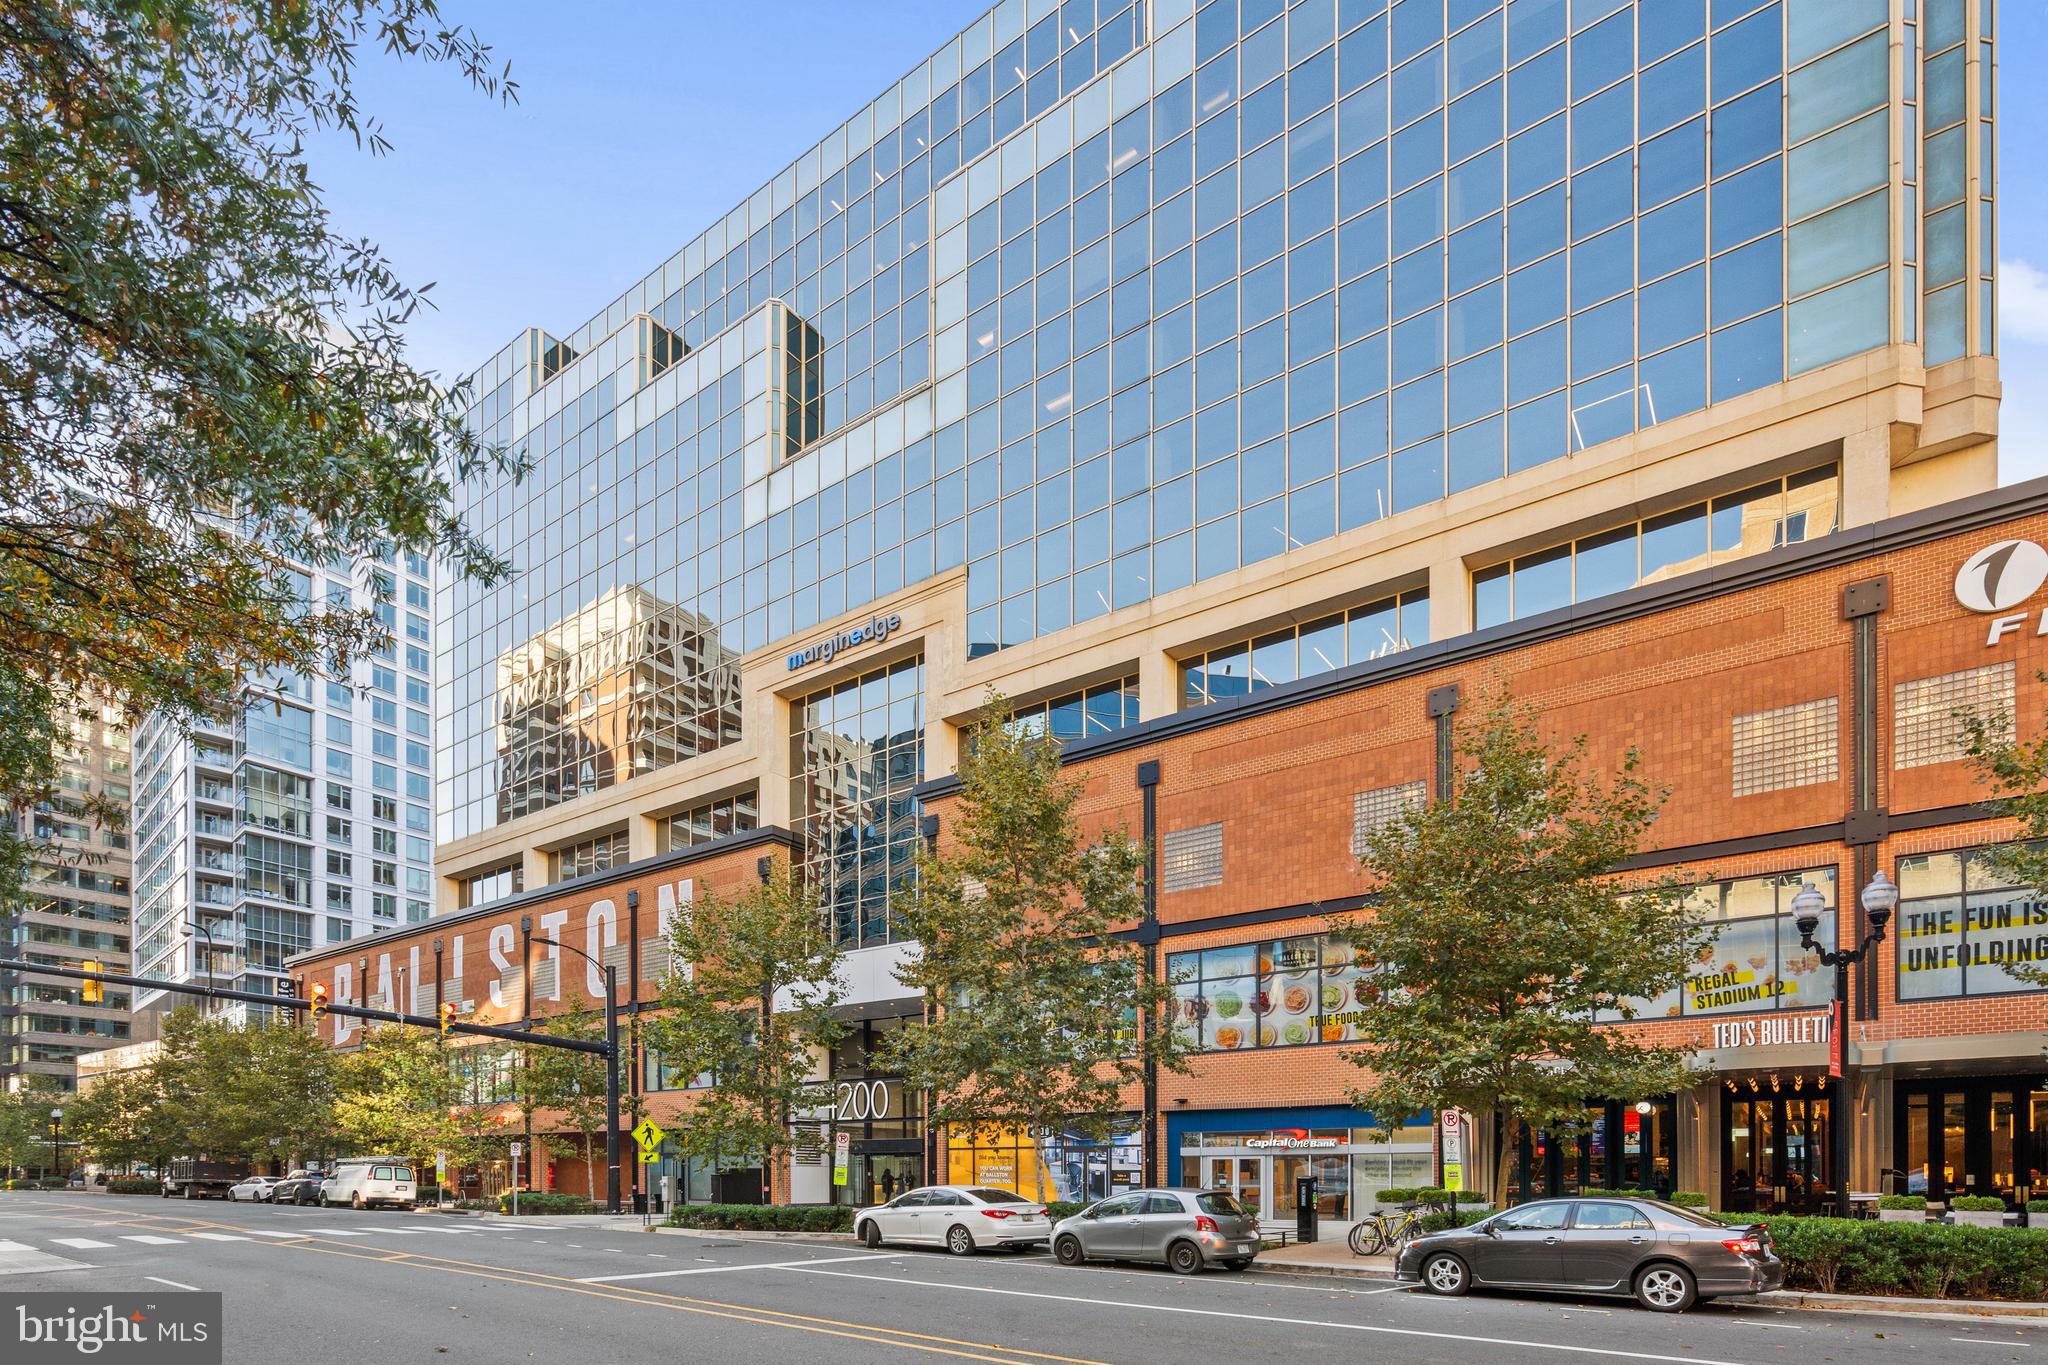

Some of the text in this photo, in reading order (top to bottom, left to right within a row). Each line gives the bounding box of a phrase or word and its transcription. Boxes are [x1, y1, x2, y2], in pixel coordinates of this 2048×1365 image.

[787, 613, 901, 671] marginedge
[1908, 901, 2048, 938] THE FUN IS
[1908, 936, 2048, 972] UNFOLDING
[1694, 971, 1740, 992] REGAL
[1697, 981, 1786, 1010] STADIUM 12
[1712, 1020, 1757, 1049] TED'S
[1310, 1139, 1337, 1148] Bank
